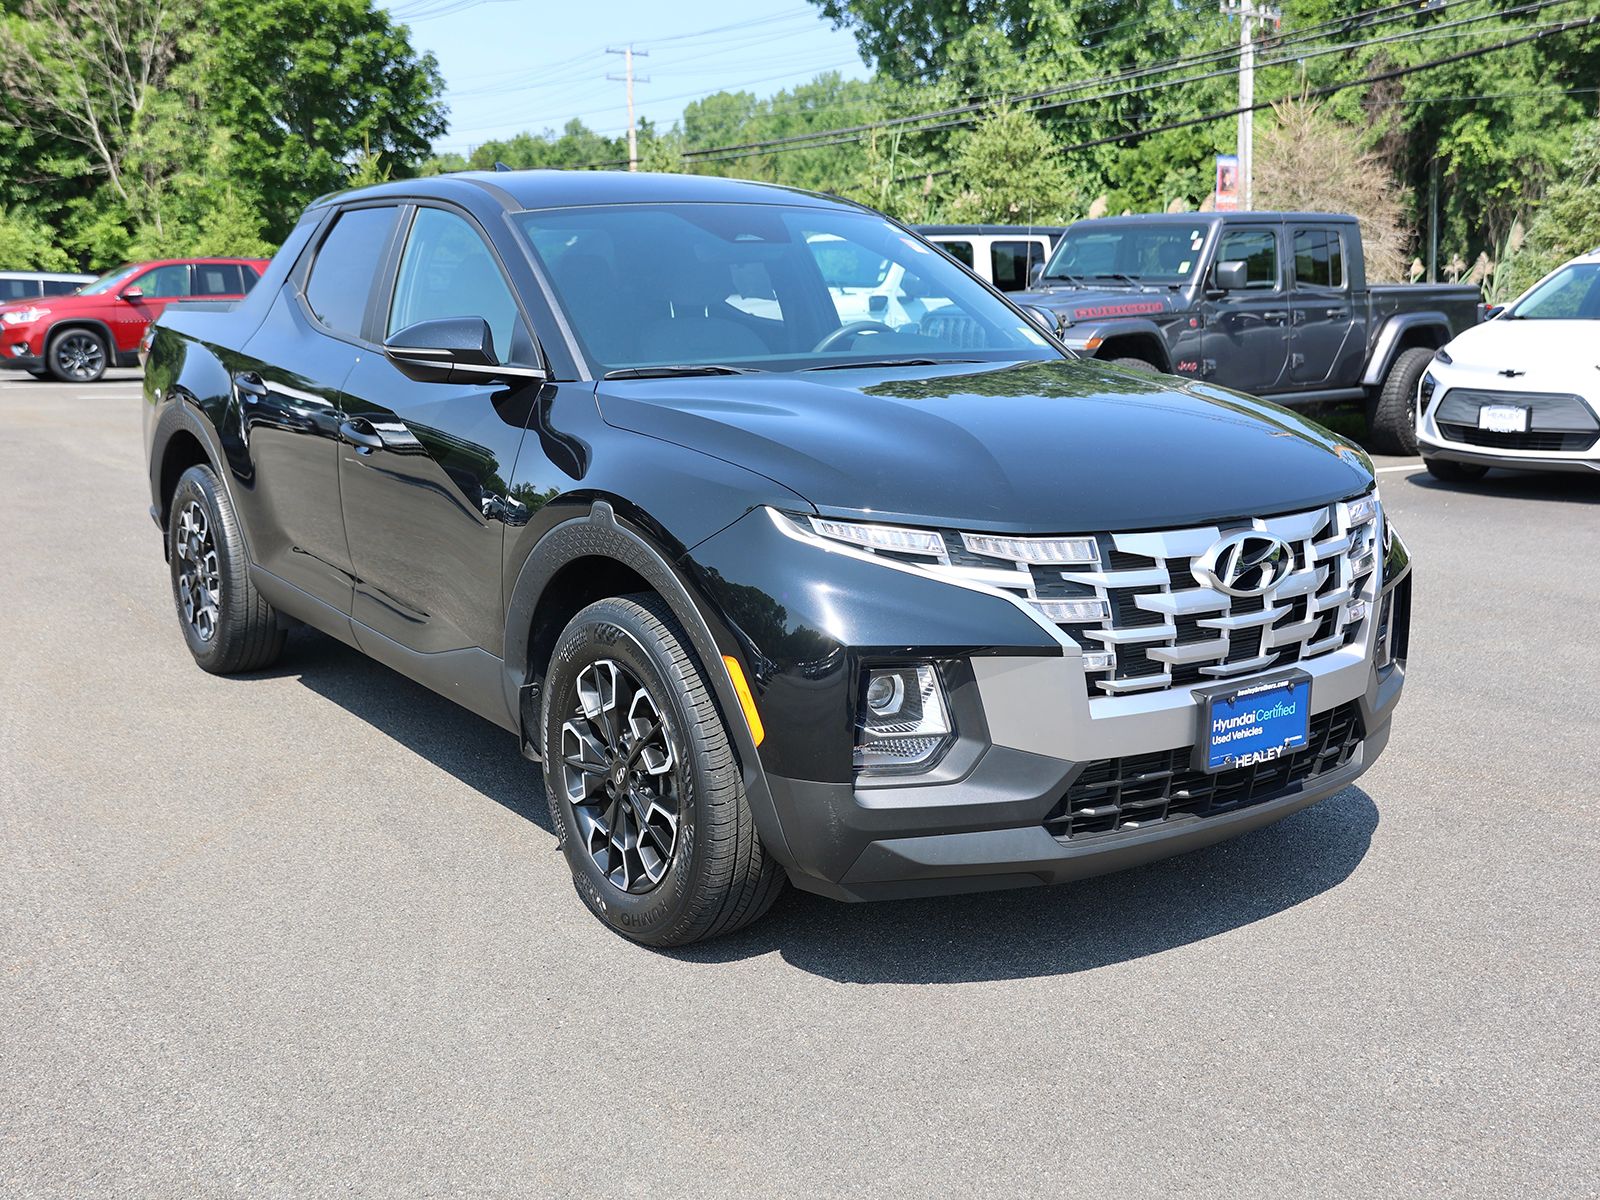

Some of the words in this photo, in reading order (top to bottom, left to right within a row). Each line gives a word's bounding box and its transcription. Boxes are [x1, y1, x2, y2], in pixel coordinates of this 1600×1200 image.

[1075, 302, 1163, 318] RUBICON
[1213, 711, 1255, 732] Hyundai
[1256, 701, 1296, 721] Certified
[1212, 732, 1231, 745] Used
[1232, 726, 1263, 740] Vehicles
[1235, 745, 1284, 768] HEALEY
[621, 899, 668, 927] KUMHO
